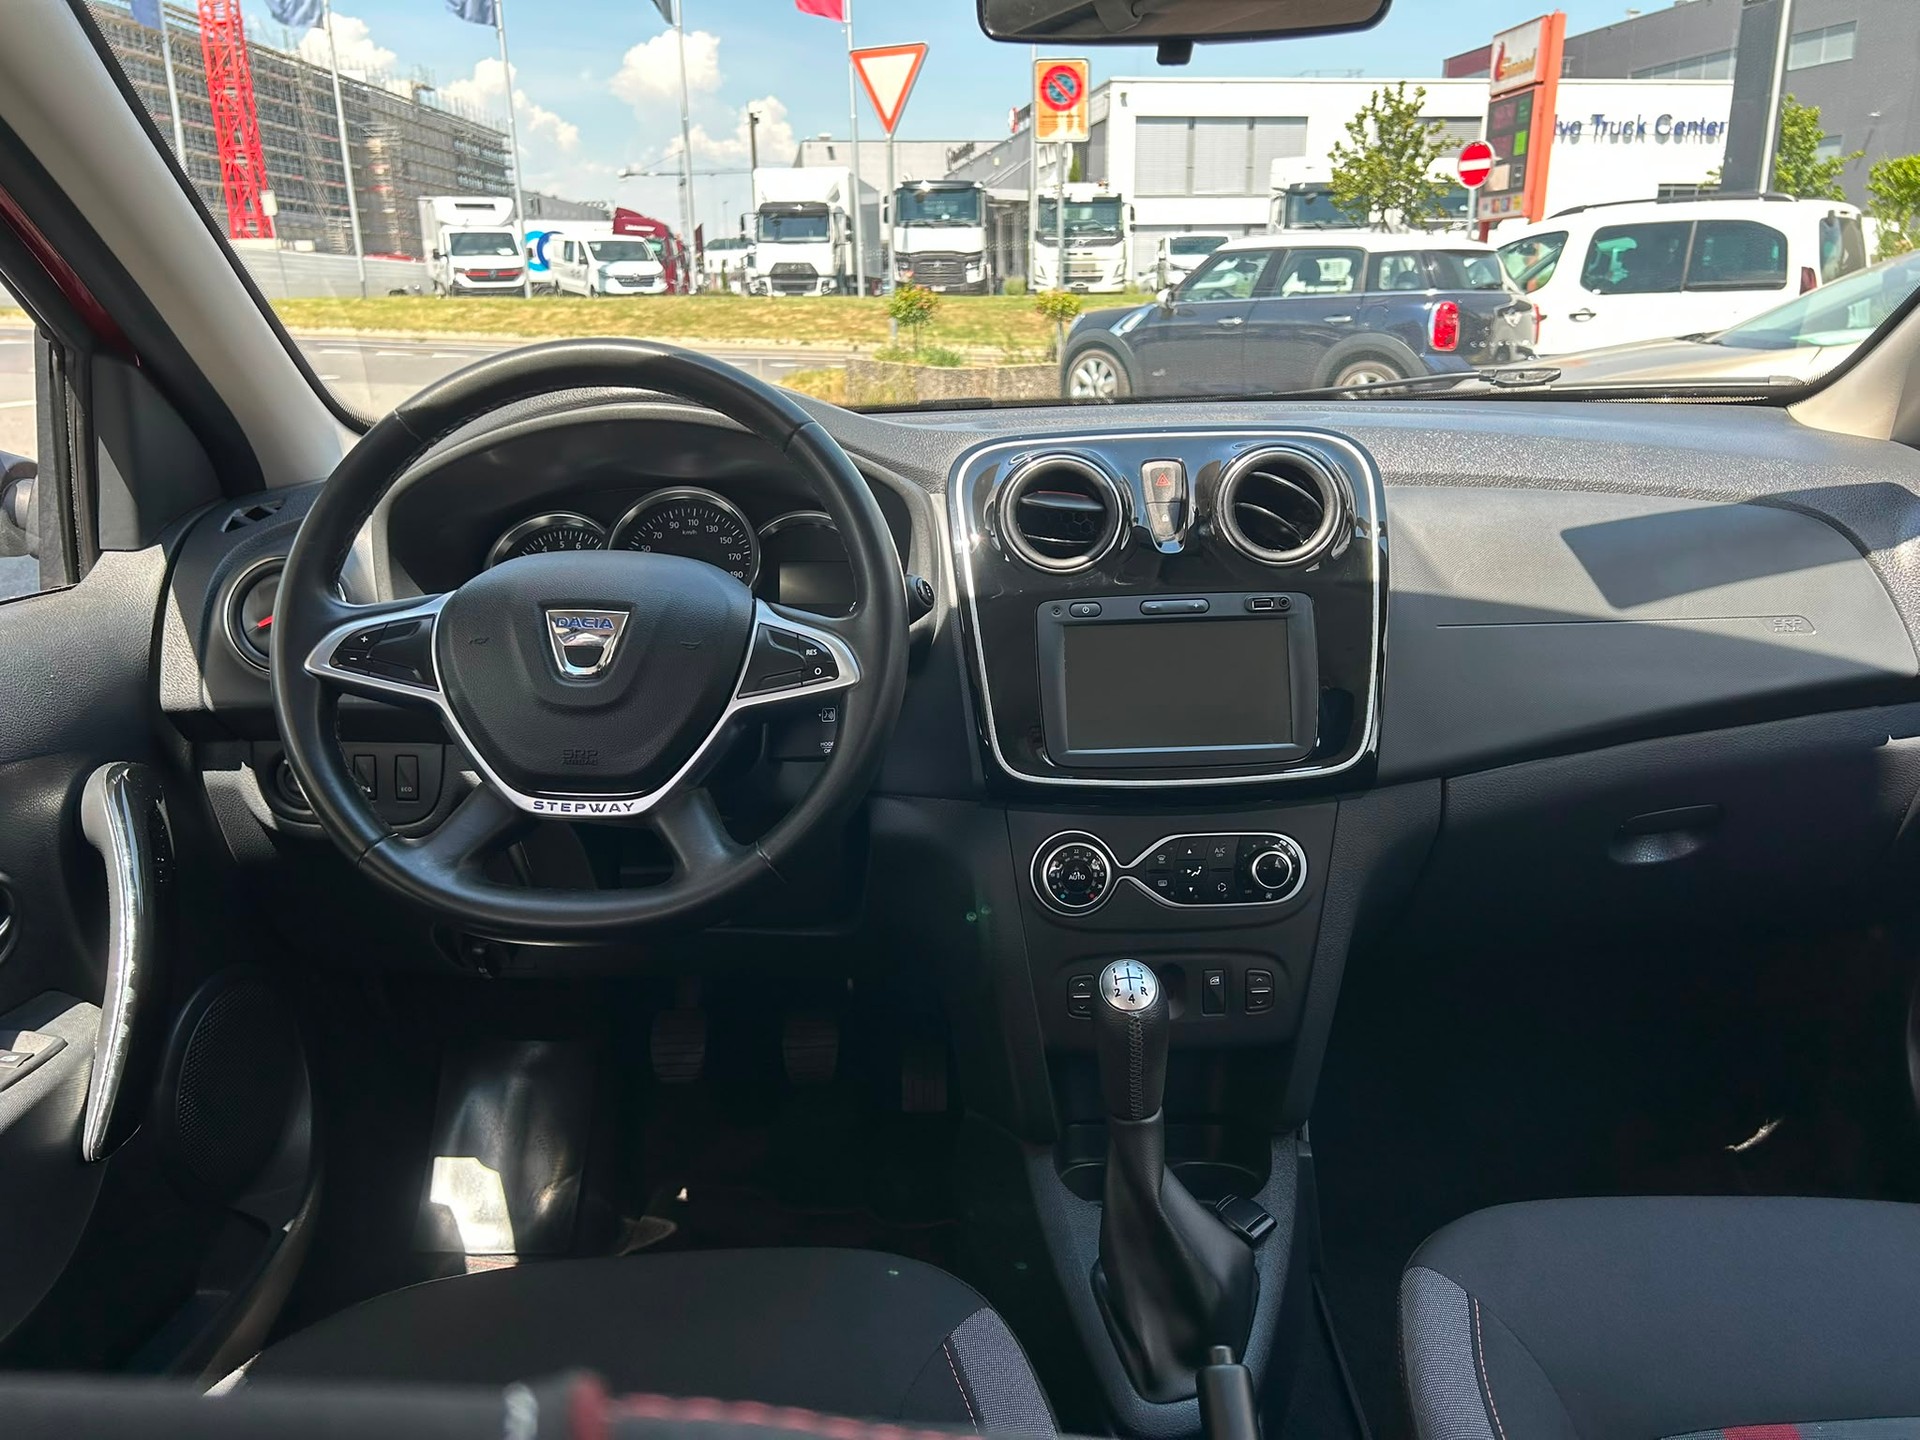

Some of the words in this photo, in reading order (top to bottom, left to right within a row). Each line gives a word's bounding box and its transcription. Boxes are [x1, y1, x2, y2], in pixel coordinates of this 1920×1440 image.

[1553, 114, 1582, 136] lvo
[1590, 113, 1647, 136] Truck
[1655, 114, 1724, 136] Center
[669, 521, 680, 529] 90
[706, 525, 718, 533] 130
[720, 536, 732, 544] 150
[556, 616, 614, 630] DACIA
[533, 800, 634, 813] STEPWAY
[1068, 873, 1086, 881] AUTO
[1114, 988, 1121, 997] 2
[1140, 986, 1148, 996] R
[1128, 993, 1136, 1004] 4
